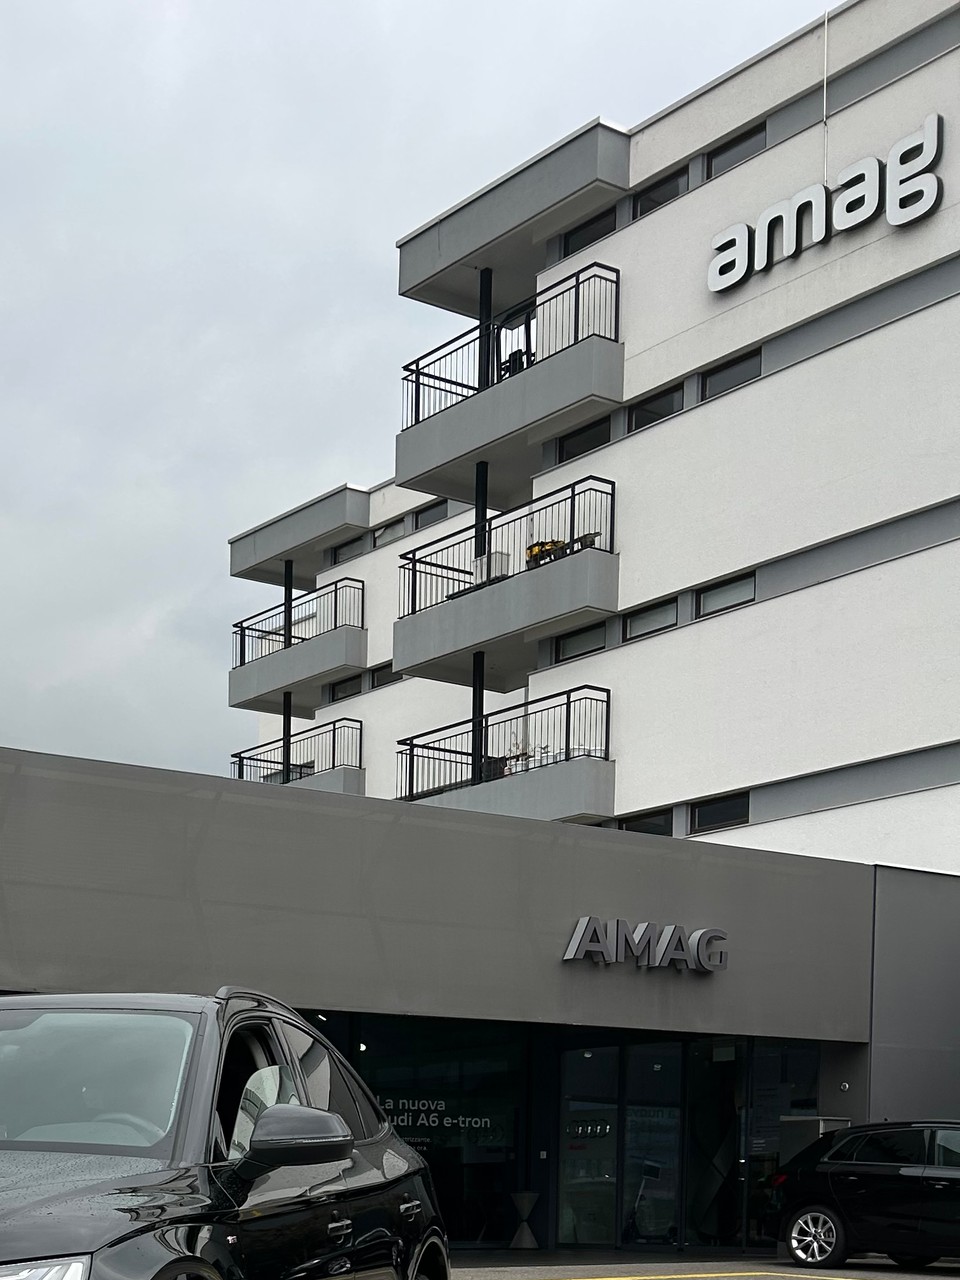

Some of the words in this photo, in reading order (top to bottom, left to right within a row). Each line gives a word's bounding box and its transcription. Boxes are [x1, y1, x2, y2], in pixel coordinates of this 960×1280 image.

[707, 112, 943, 293] amag
[563, 916, 728, 972] AMAG
[388, 1112, 413, 1126] udi
[416, 1113, 439, 1127] A6
[443, 1115, 491, 1128] e-tron
[399, 1099, 446, 1111] nuova
